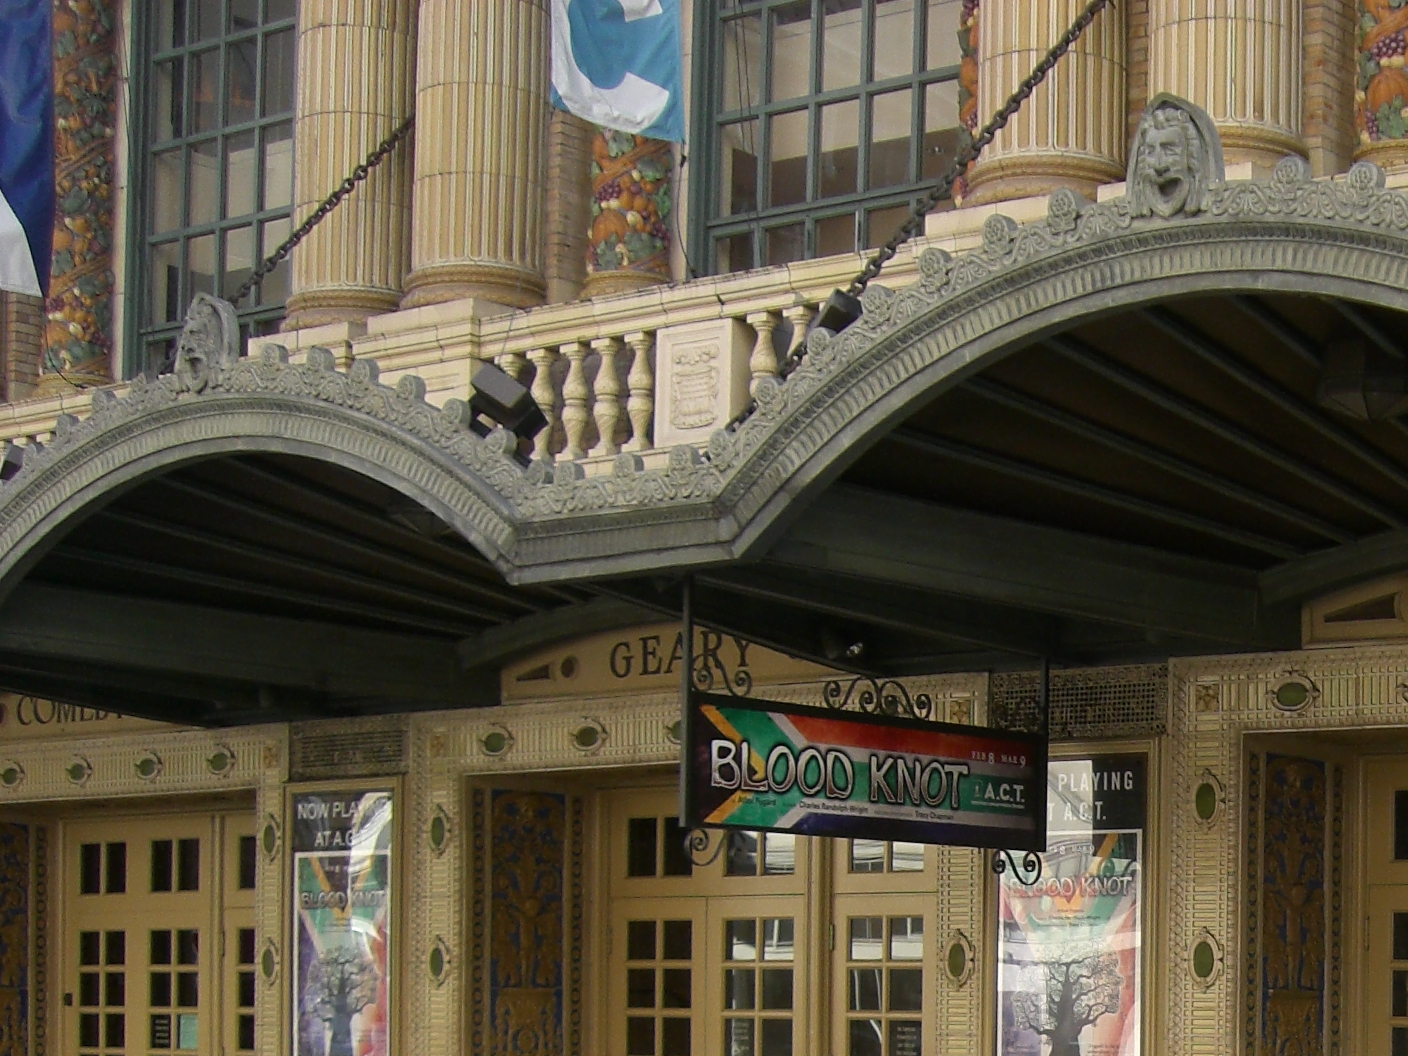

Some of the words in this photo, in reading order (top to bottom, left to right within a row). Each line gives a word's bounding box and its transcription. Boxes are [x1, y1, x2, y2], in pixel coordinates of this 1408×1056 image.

[711, 738, 854, 799] BLOOD
[869, 754, 969, 809] KNOT
[1057, 770, 1134, 792] PLAYING
[984, 782, 1026, 802] A.C.T.
[297, 802, 329, 819] NOW
[1063, 801, 1107, 821] A.C.T.
[314, 830, 331, 848] AT
[1081, 876, 1133, 896] KNOT
